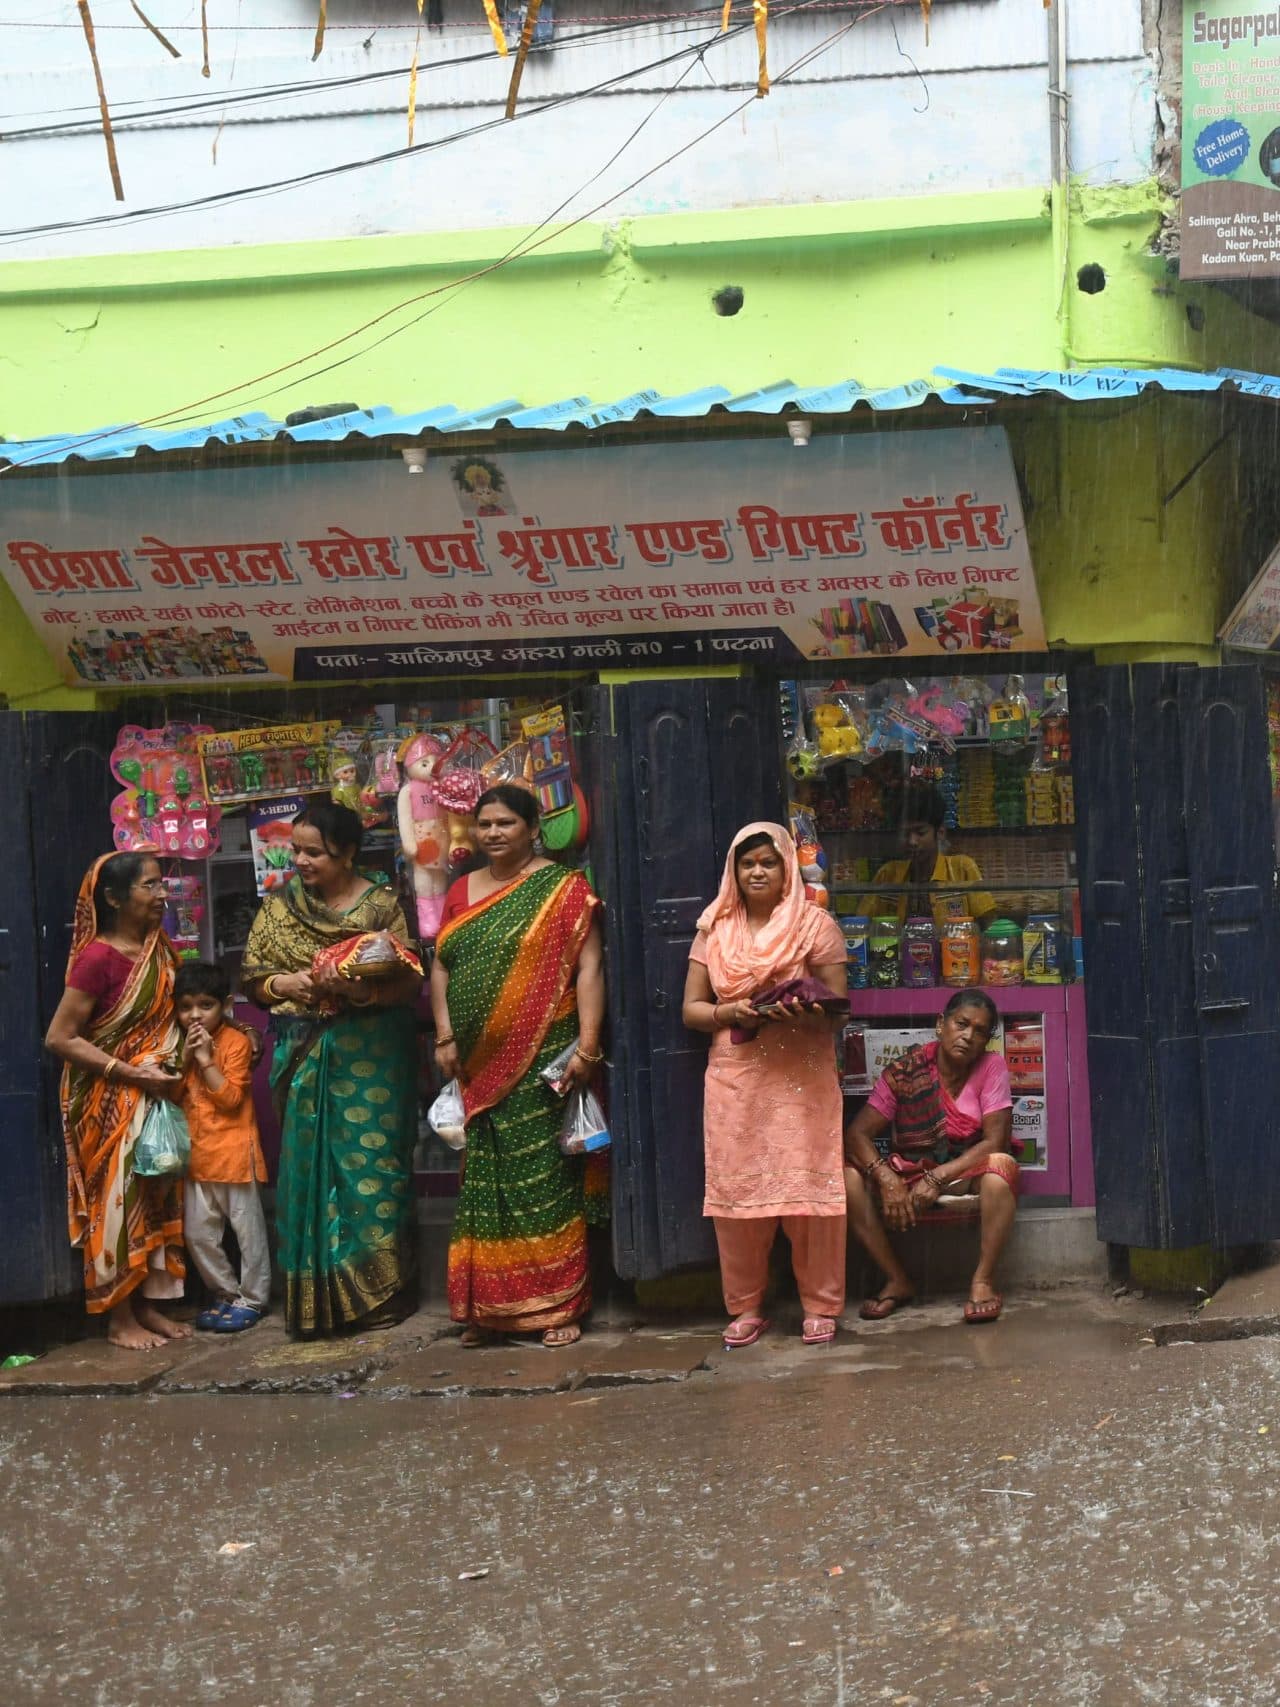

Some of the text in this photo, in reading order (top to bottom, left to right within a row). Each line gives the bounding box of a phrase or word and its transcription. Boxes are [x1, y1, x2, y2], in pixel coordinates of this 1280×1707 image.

[1193, 62, 1224, 74] Deals
[1199, 75, 1228, 88] Toilet
[1197, 128, 1244, 157] Free Home
[1206, 145, 1243, 168] Delivery
[1189, 215, 1231, 228] Salimpur
[1234, 213, 1260, 225] Ahra,
[1217, 227, 1237, 238] Gali
[1240, 226, 1256, 237] No.
[1226, 239, 1250, 250] Near
[1202, 252, 1236, 264] Kadam
[1239, 250, 1268, 262] Kuan,
[7, 541, 135, 592] प्रिशा
[133, 536, 295, 581] जेनरल
[298, 527, 400, 579] स्टोर
[405, 520, 485, 574] एवं
[625, 520, 728, 563] एण्ड
[737, 505, 861, 556] गिफ्ट
[872, 493, 1005, 551] कॉर्नर
[41, 608, 81, 624] नोट
[95, 606, 151, 624] हमारे
[462, 591, 484, 608] के
[489, 592, 543, 609] स्कूल
[548, 589, 590, 604] एण्ड
[649, 585, 677, 599] का
[682, 582, 746, 597] समान
[746, 576, 776, 594] एवं
[780, 580, 810, 593] हर
[818, 575, 884, 592] अवसर
[888, 571, 915, 587] के
[915, 568, 958, 586] लिए
[963, 566, 1021, 585] गिफ्ट
[273, 619, 342, 638] आईटम
[345, 620, 361, 633] व
[363, 616, 418, 633] गिफ्ट
[485, 611, 513, 628] भी
[518, 609, 569, 627] उचित
[574, 609, 623, 628] मूल्य
[628, 607, 658, 622] पर
[662, 602, 714, 620] किया
[722, 601, 768, 617] जाता
[388, 647, 494, 668] सालिमपुर
[502, 647, 566, 660] अहरा
[571, 640, 623, 658] गली
[711, 636, 775, 652] पटना
[239, 733, 264, 748] HERO
[259, 804, 297, 816] X-HERO
[1013, 1114, 1040, 1125] Board
